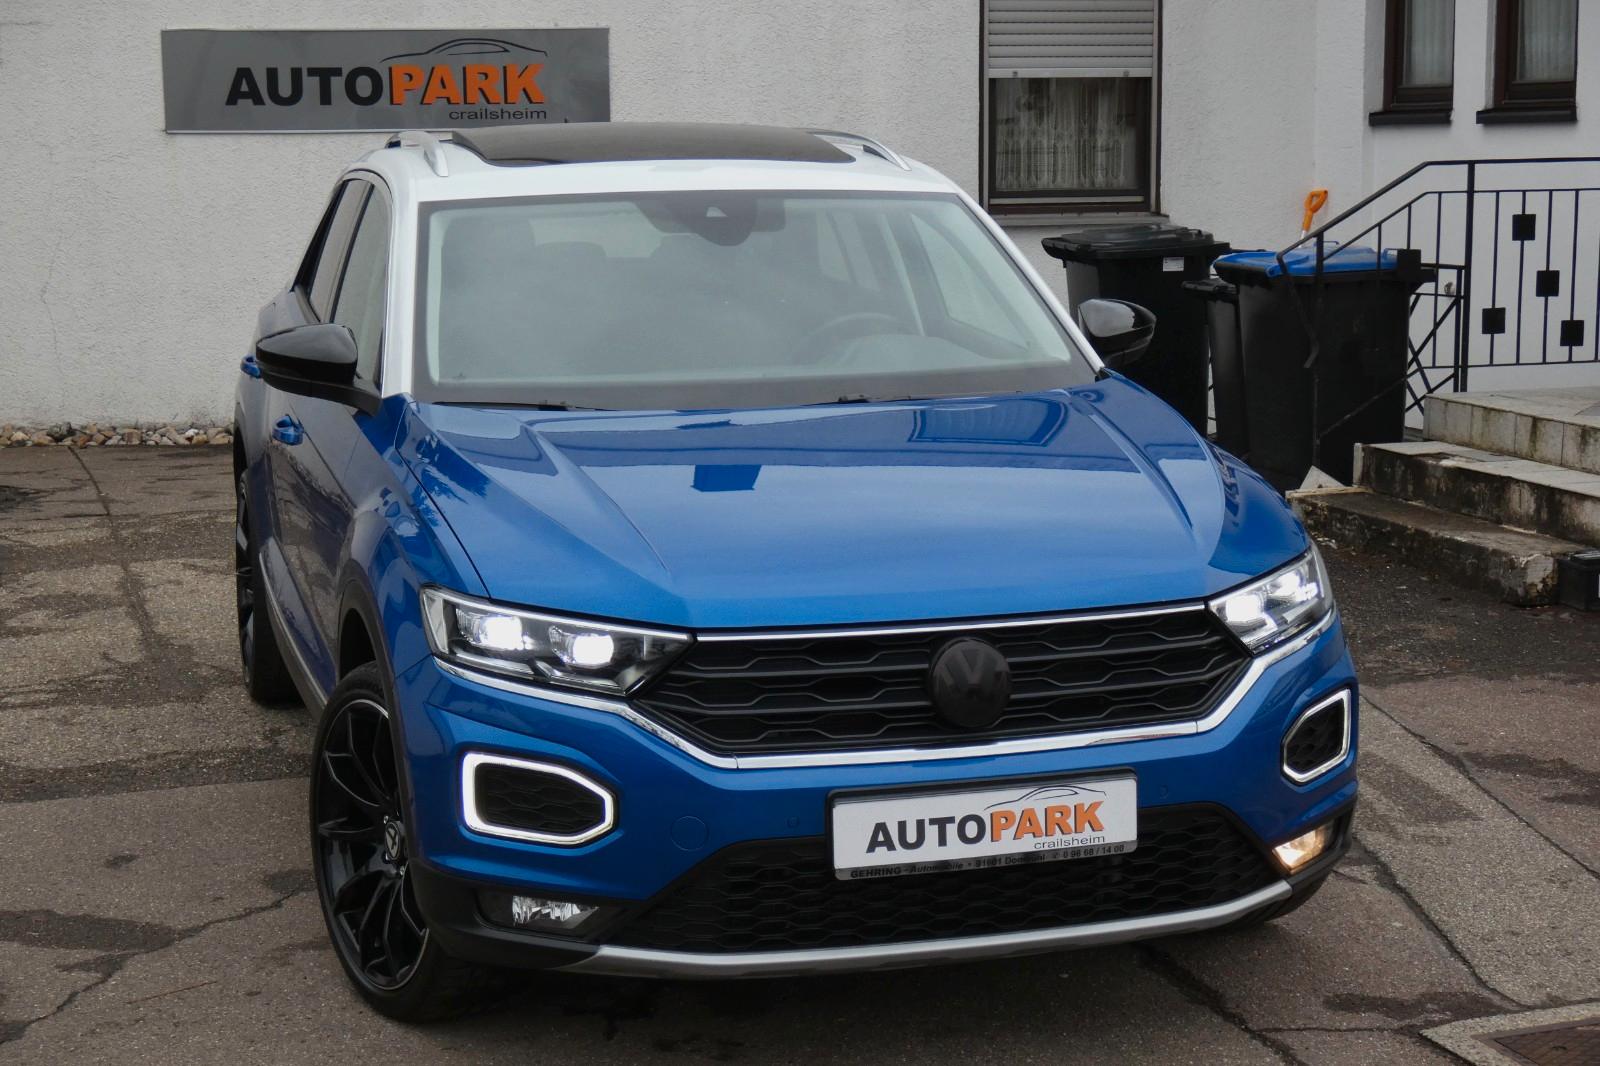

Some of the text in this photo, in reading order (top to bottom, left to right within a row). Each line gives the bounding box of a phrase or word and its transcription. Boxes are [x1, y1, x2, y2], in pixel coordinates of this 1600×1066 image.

[225, 63, 545, 105] AUTOPARK
[448, 108, 548, 120] crailsheim
[865, 801, 1105, 853] AUTOPARK
[1034, 834, 1105, 849] crailsheim
